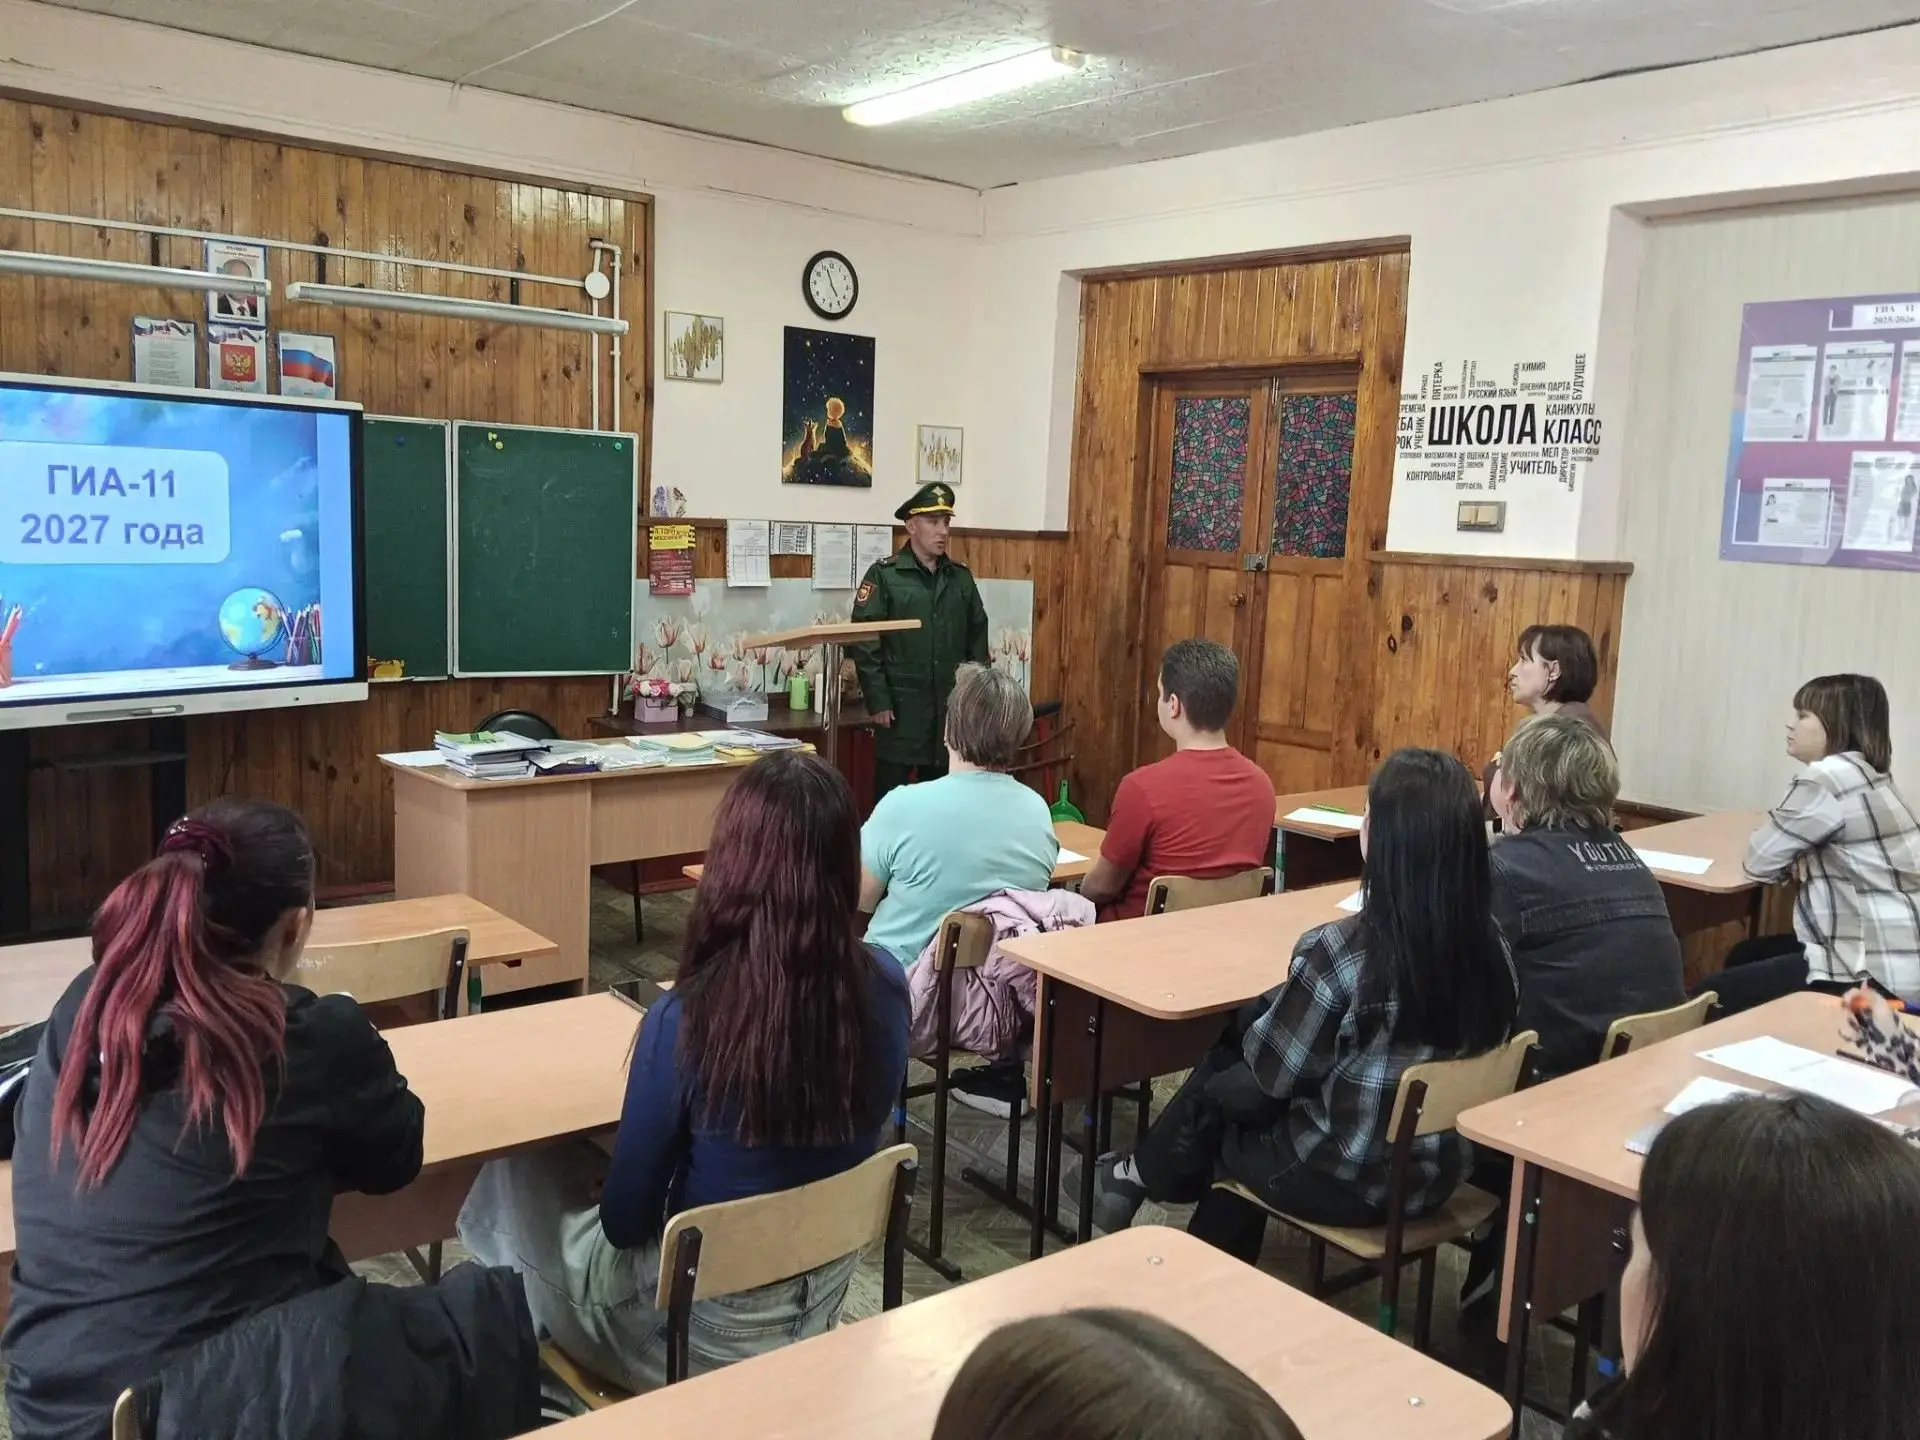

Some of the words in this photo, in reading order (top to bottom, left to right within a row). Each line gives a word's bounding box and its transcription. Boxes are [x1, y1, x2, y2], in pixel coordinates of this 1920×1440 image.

[1521, 361, 1546, 371] ХИМИЯ
[1432, 361, 1442, 401] ПЯТЕРКА
[1572, 352, 1586, 400] БУДУЩЕЕ
[1468, 389, 1497, 399] РУССКИЙ
[1498, 388, 1518, 398] ЯЗЫК
[1520, 382, 1547, 391] ДНЕВНИК
[1547, 381, 1571, 391] ПАРТА
[1400, 403, 1426, 414] РЕМЕНА
[1545, 403, 1596, 416] КАНИКУЛЫ
[1428, 403, 1537, 446] ШКОЛА
[1543, 418, 1602, 445] КЛАСС
[1414, 416, 1425, 450] УЧЕНИК
[1466, 451, 1490, 460] ОЦЕНКА
[1541, 447, 1559, 458] МЕЛ
[1488, 451, 1499, 490] ДОМАШНЕЕ
[1498, 451, 1509, 483] ЗАДАНИЕ
[1510, 460, 1558, 475] УЧИТЕЛЬ
[1559, 446, 1569, 483] ДИРЕКТОР
[47, 464, 176, 498] ГИА-11
[1406, 471, 1456, 481] КОНТРОЛЬНАЯ
[20, 512, 110, 544] 2027
[124, 522, 204, 550] года
